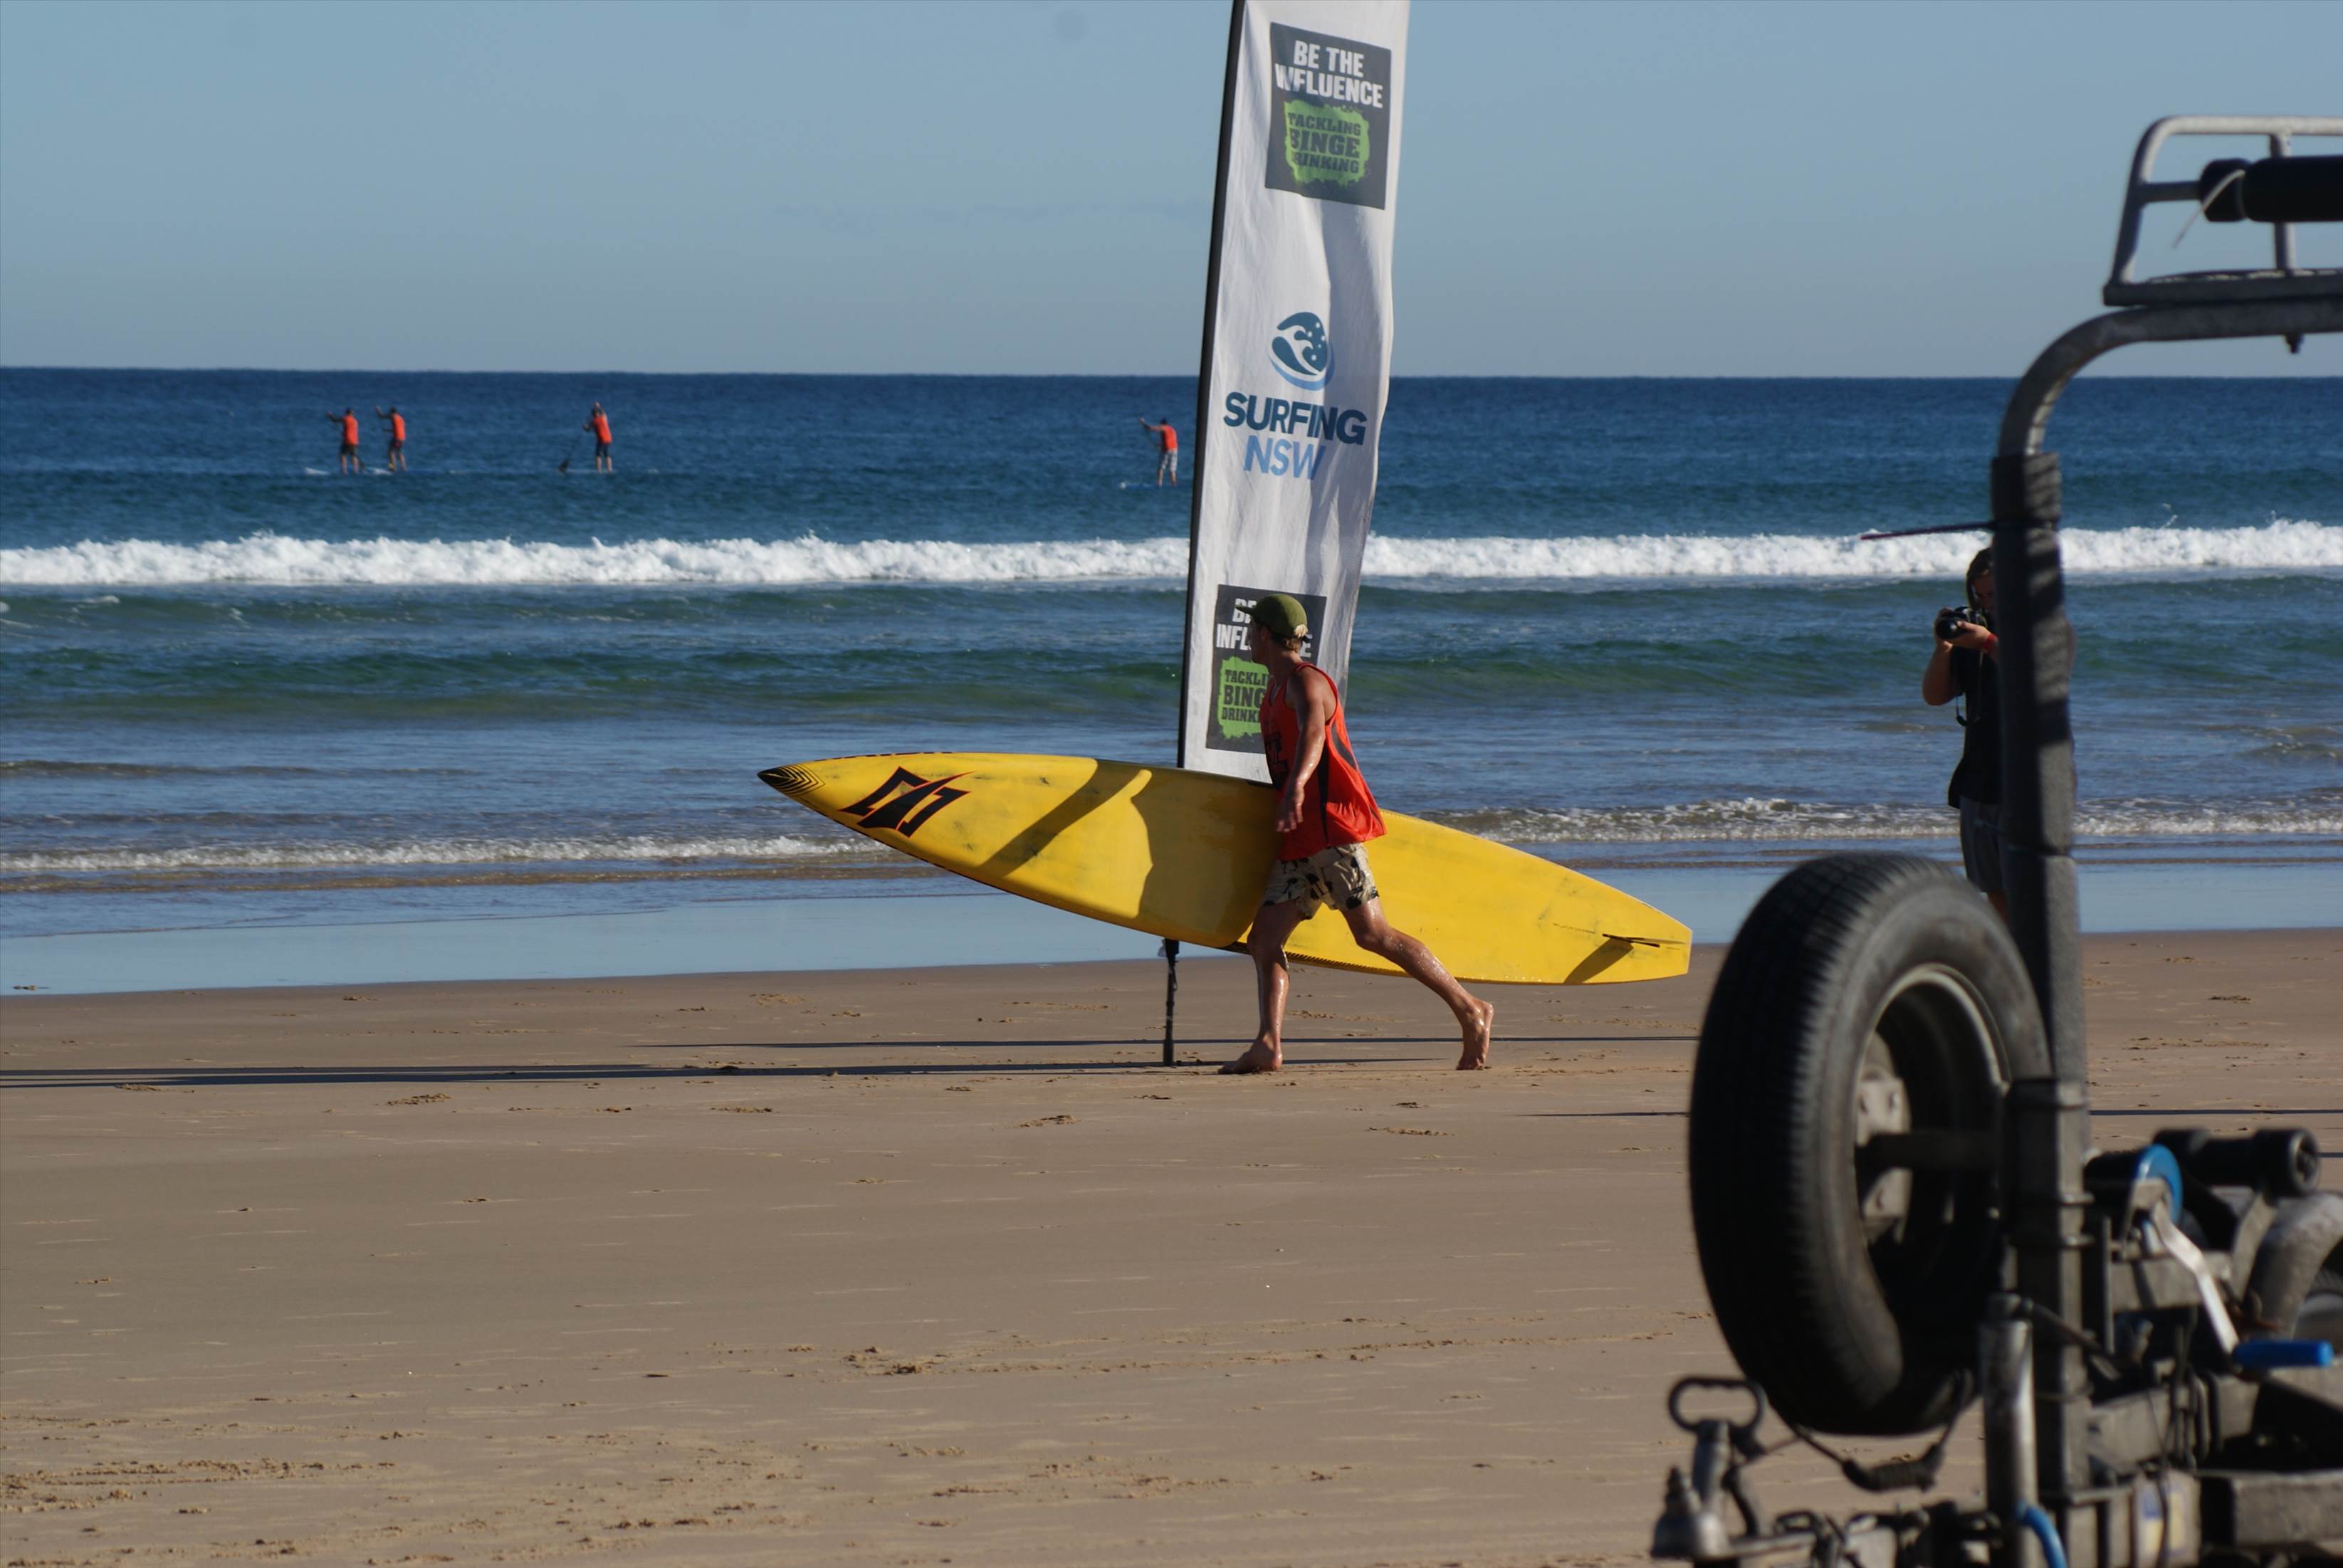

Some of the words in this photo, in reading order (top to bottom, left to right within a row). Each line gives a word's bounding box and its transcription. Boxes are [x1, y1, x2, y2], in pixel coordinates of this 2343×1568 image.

[1293, 40, 1320, 69] BE
[1326, 46, 1364, 78] THE
[1287, 112, 1361, 136] TACKLING
[1290, 127, 1361, 159] BINGE
[1292, 151, 1359, 174] RINKING
[1223, 391, 1368, 446] SURFING
[1243, 435, 1326, 480] NSW
[1225, 669, 1269, 686] TACKLI
[1223, 684, 1265, 707] BING
[1221, 707, 1259, 723] DRINK
